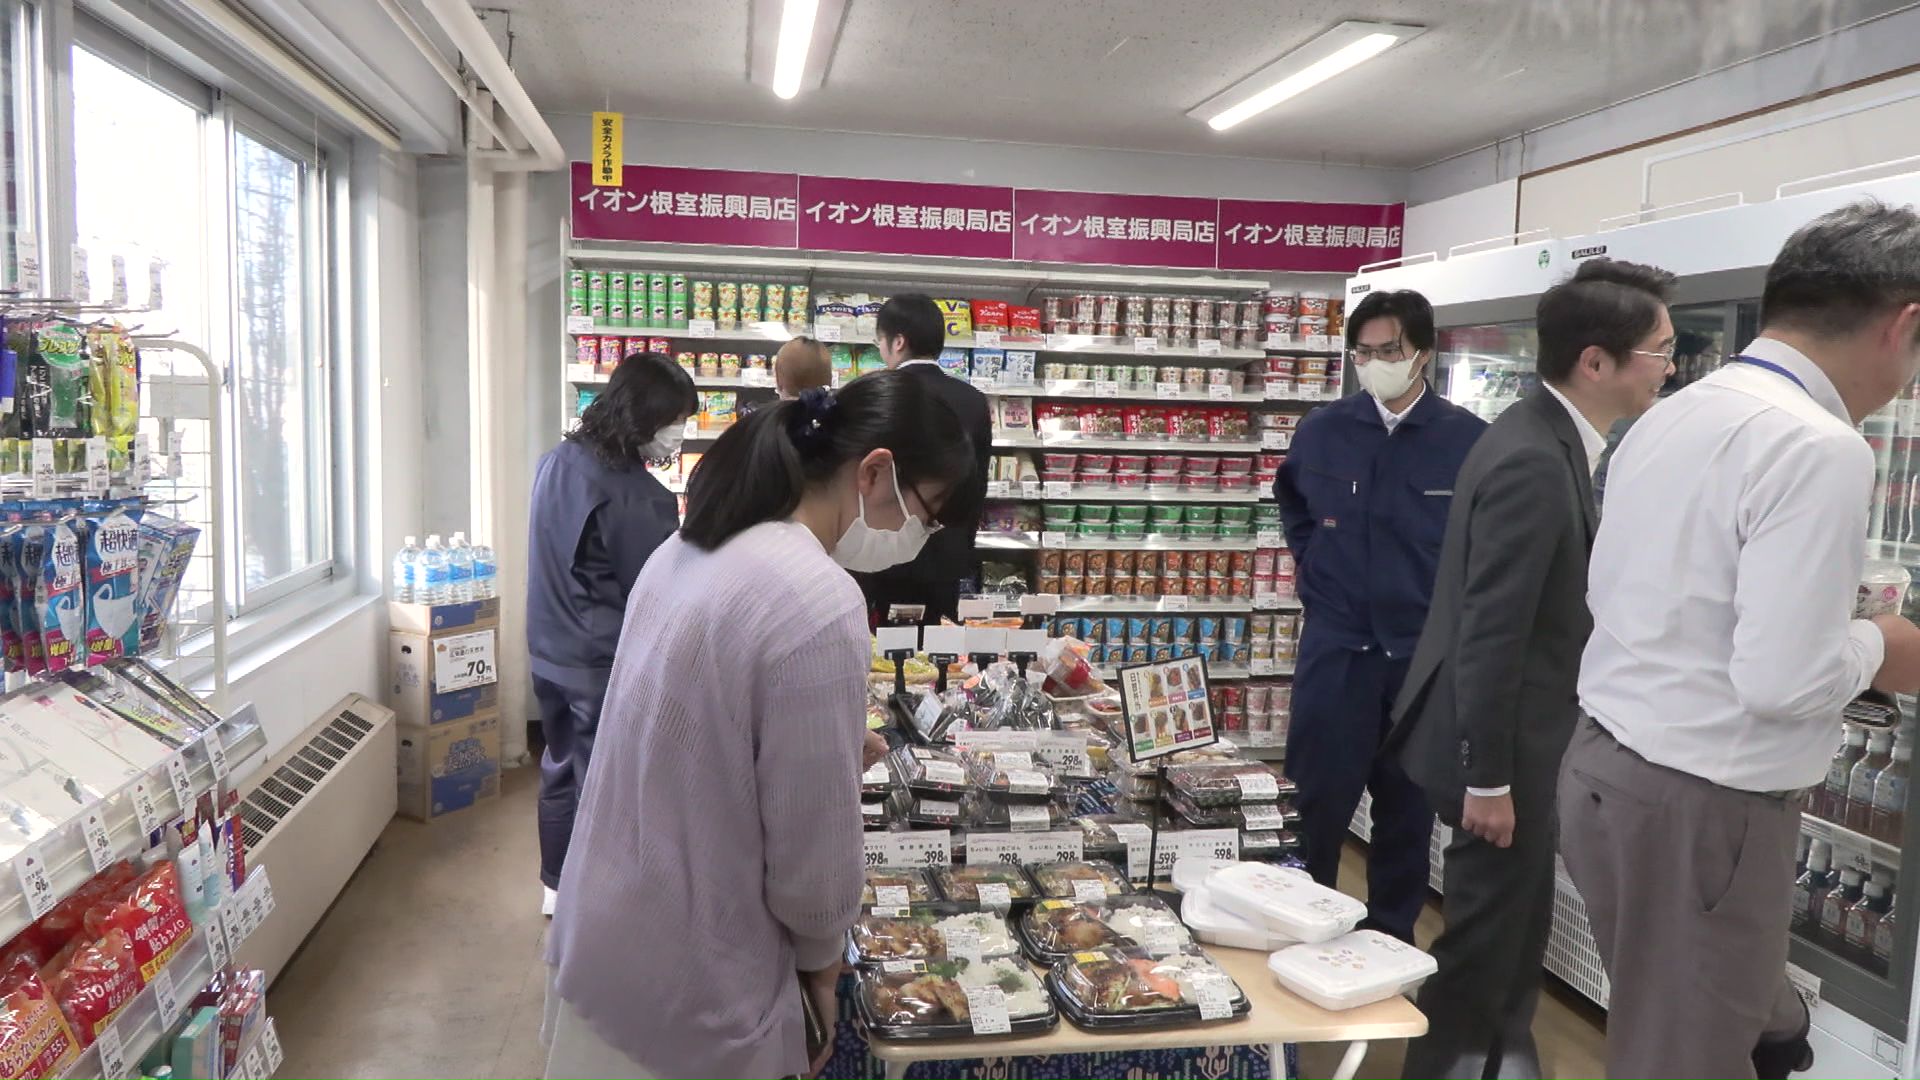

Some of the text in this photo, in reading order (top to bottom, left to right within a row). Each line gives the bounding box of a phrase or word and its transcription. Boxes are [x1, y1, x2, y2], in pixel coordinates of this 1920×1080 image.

[579, 188, 796, 221] イオン根室振興局店
[805, 200, 1011, 233] イオン根室振興局店
[1020, 213, 1216, 244] イオン根室振興局店
[1224, 221, 1400, 249] イオン根室振興局店
[100, 529, 138, 552] 超快適
[1158, 851, 1178, 865] 598
